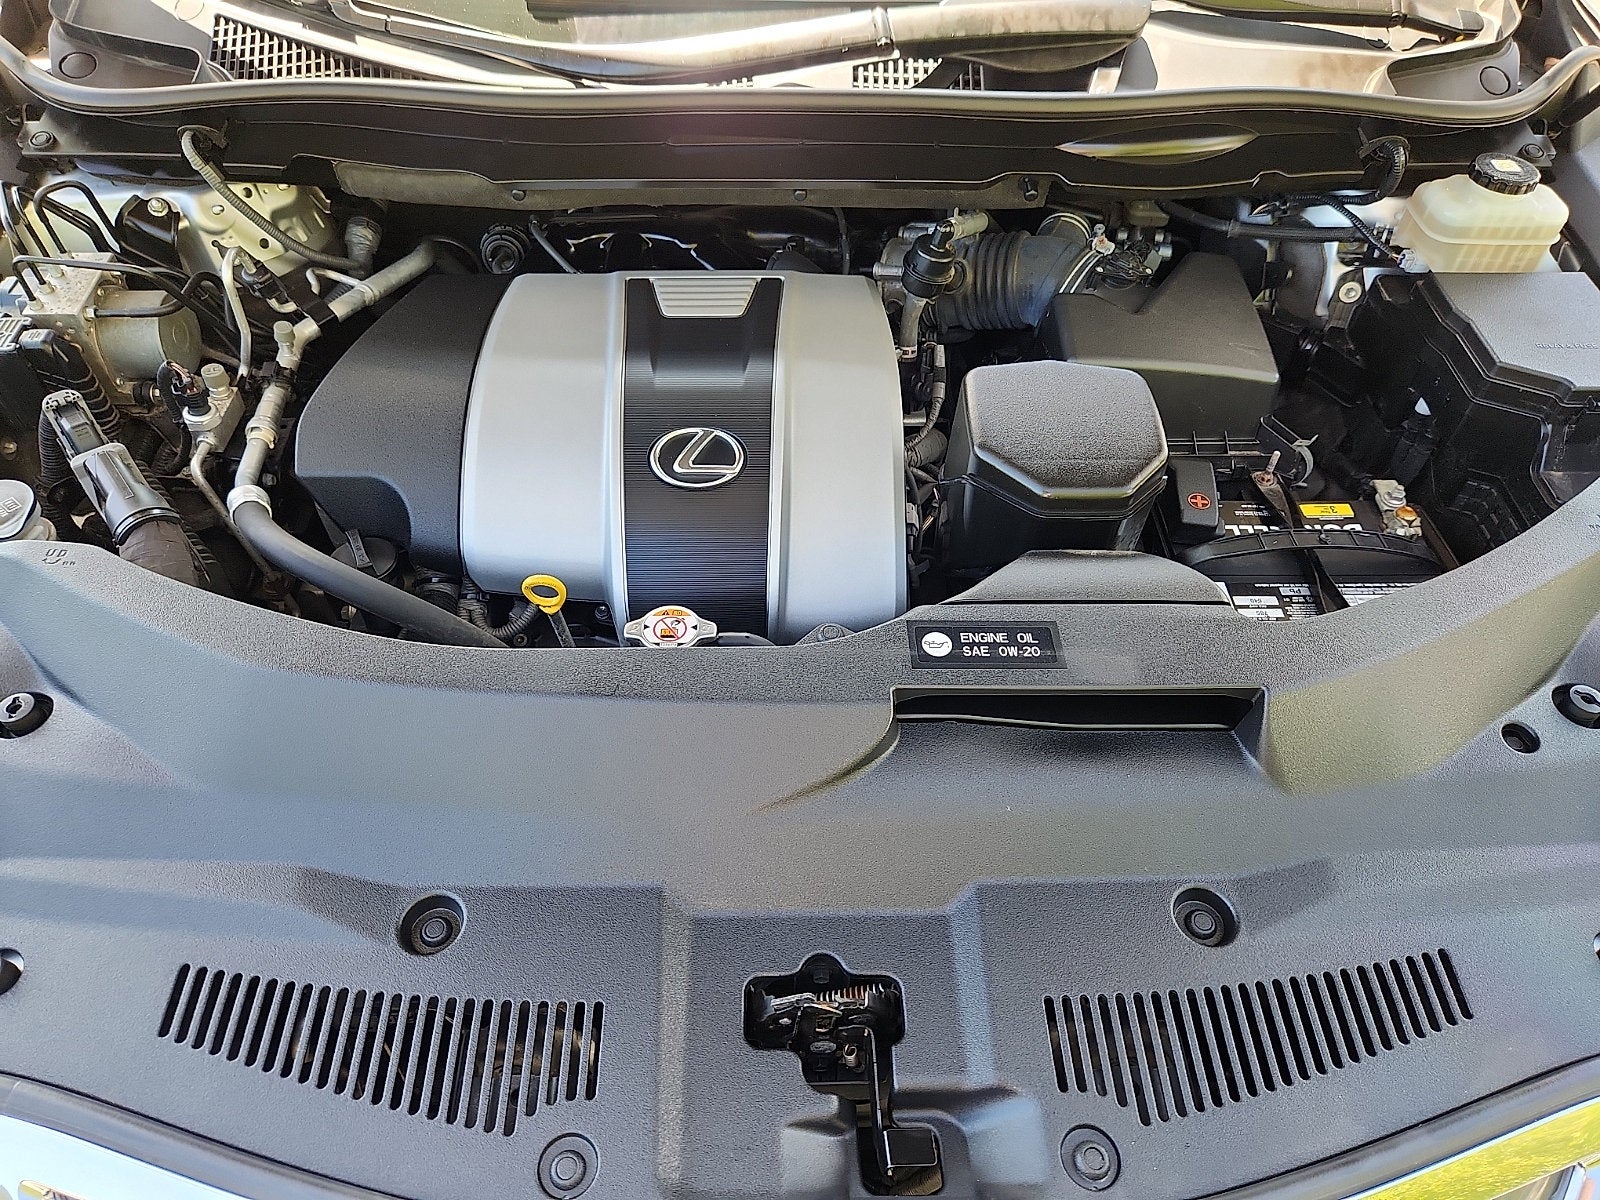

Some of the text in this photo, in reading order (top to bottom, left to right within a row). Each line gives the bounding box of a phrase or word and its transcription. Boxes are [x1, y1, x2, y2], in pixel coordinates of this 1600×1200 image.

[959, 632, 1039, 644] ENGINE OIL
[962, 646, 1041, 657] SAE 0W-20
